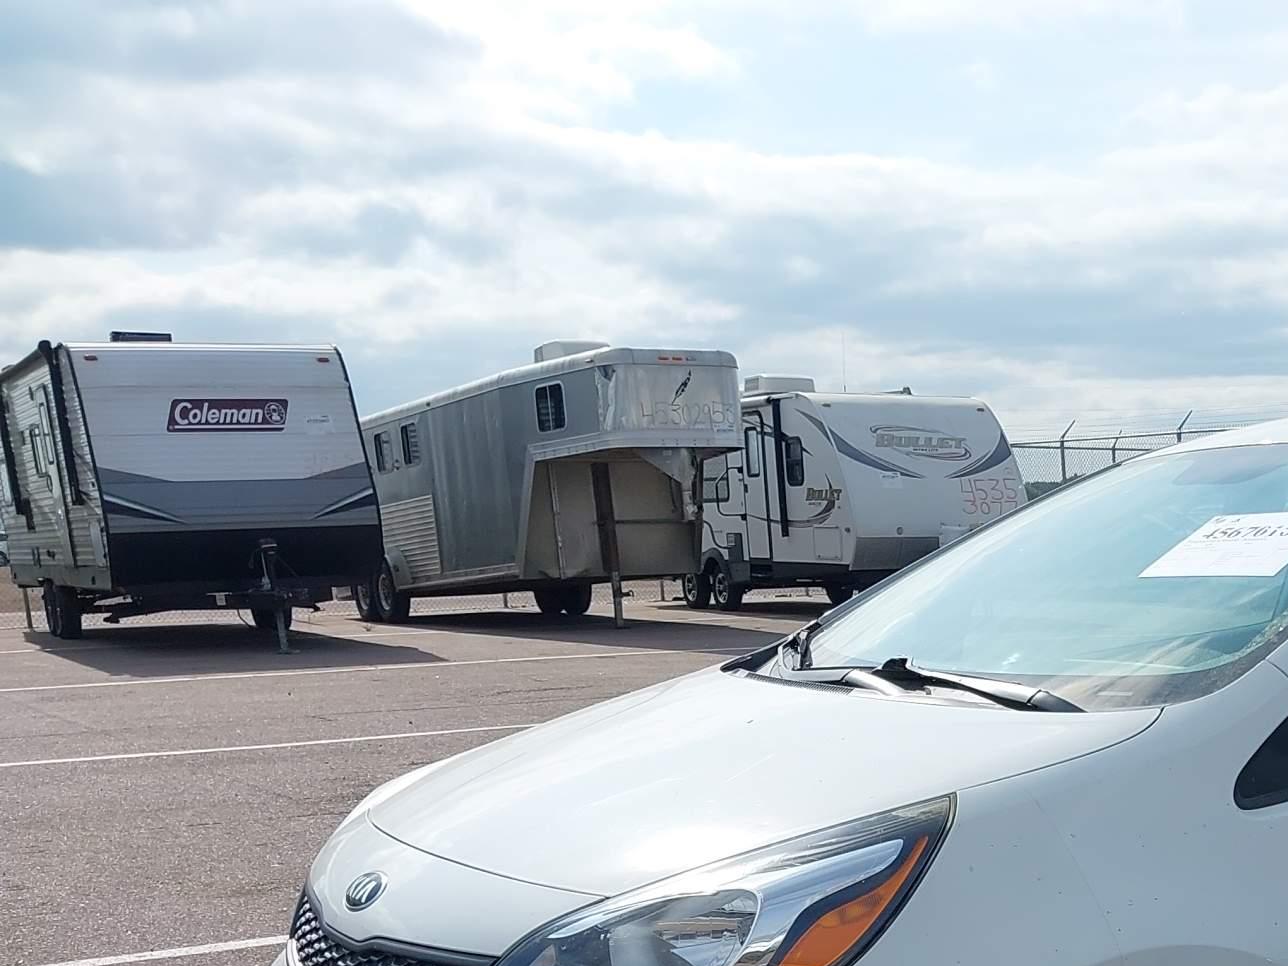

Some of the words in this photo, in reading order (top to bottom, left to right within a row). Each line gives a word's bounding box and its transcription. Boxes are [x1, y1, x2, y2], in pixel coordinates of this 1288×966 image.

[174, 402, 263, 425] Coleman
[875, 433, 967, 449] BULLET
[806, 487, 842, 501] BULLET
[960, 478, 1017, 501] 4535
